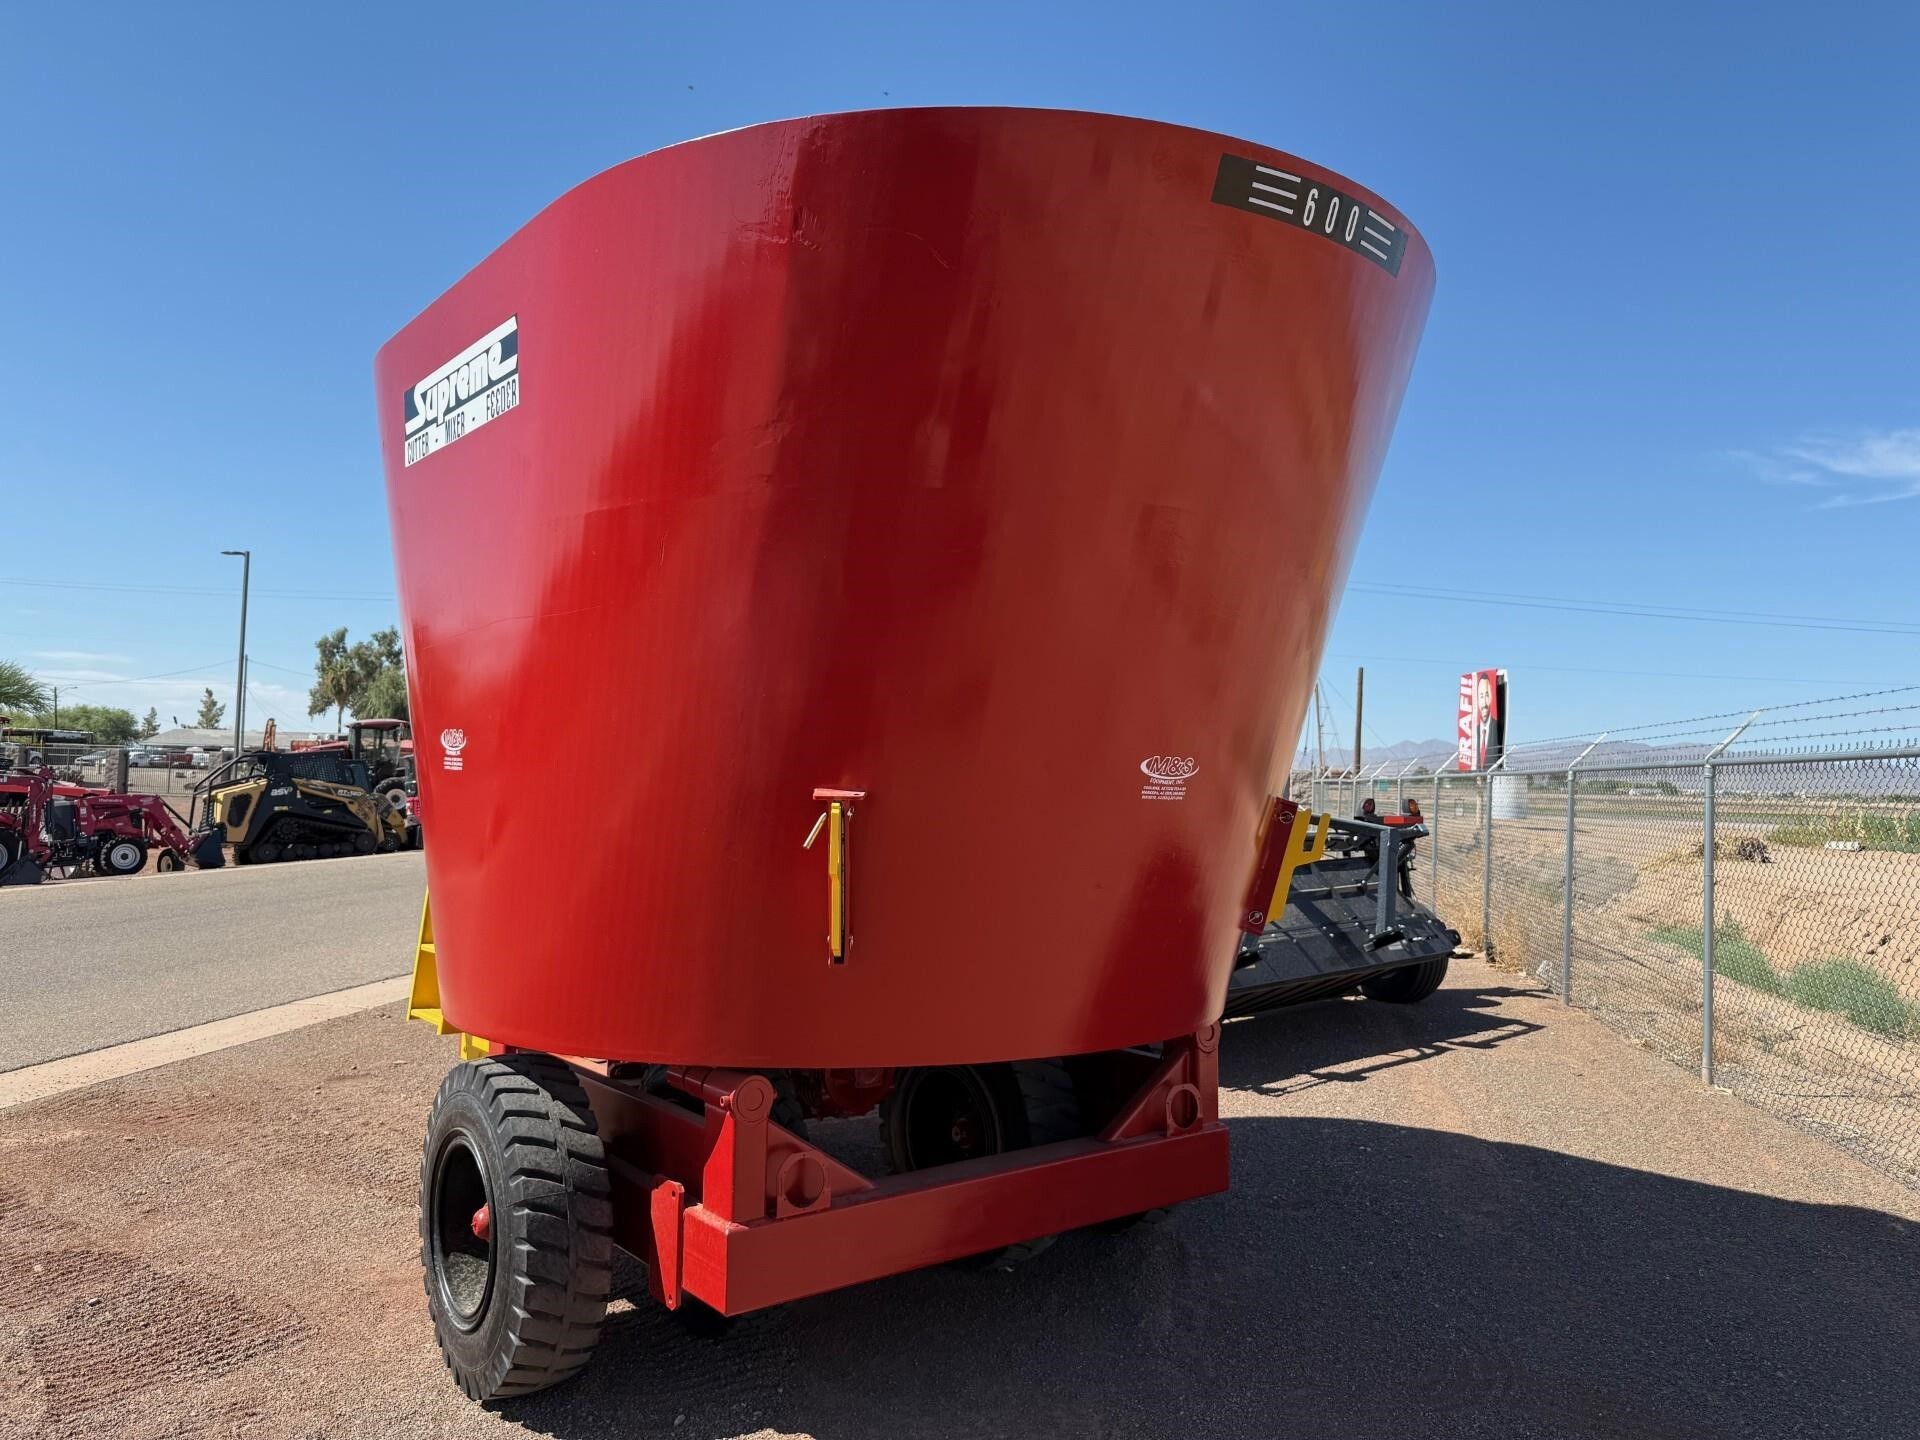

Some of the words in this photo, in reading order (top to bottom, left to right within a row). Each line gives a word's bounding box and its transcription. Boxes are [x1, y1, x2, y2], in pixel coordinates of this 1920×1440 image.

[1303, 188, 1360, 242] 600
[408, 320, 517, 434] Supreme
[407, 431, 430, 465] CUTTER
[445, 411, 466, 443] MIXER
[486, 378, 517, 421] FEEDER
[1149, 756, 1194, 775] M&S
